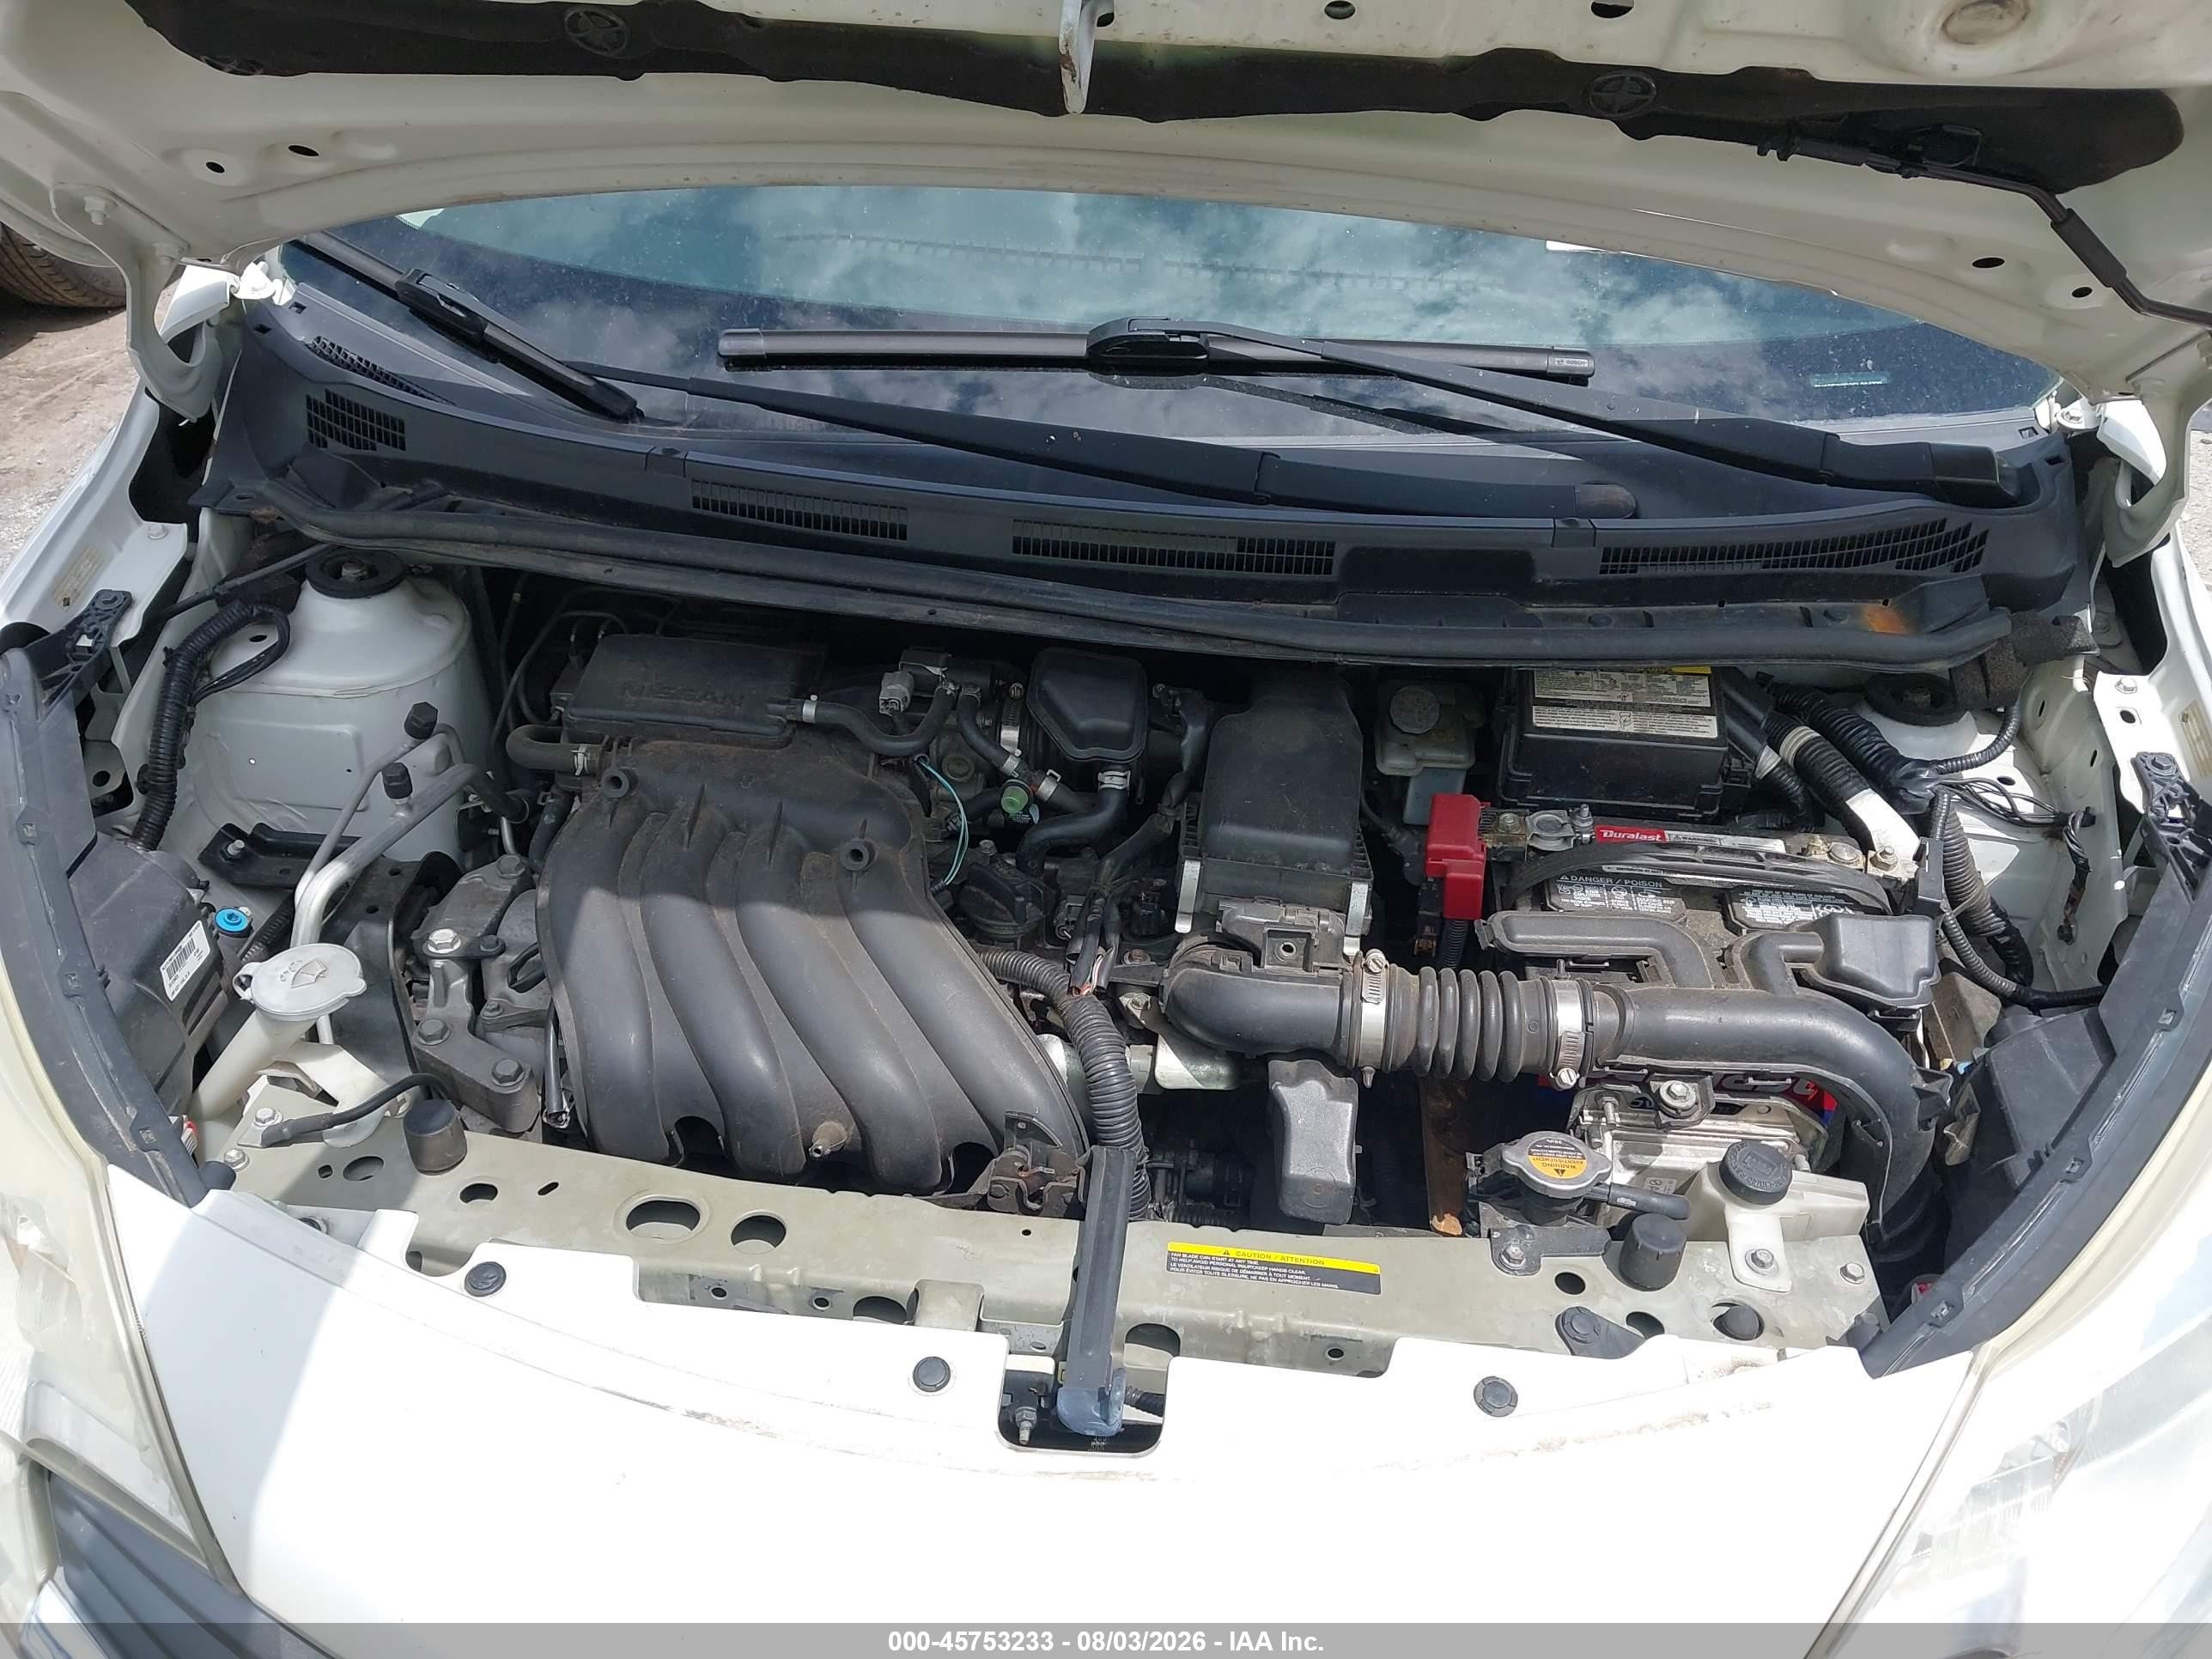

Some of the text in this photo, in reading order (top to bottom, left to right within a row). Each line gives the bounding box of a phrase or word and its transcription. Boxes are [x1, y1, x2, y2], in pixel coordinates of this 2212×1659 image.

[1600, 829, 1662, 842] Duralast
[1571, 875, 1613, 884] DANGER
[1624, 878, 1663, 888] POISON
[1236, 1251, 1272, 1260] CAUTION
[1280, 1256, 1325, 1266] ATTENTION
